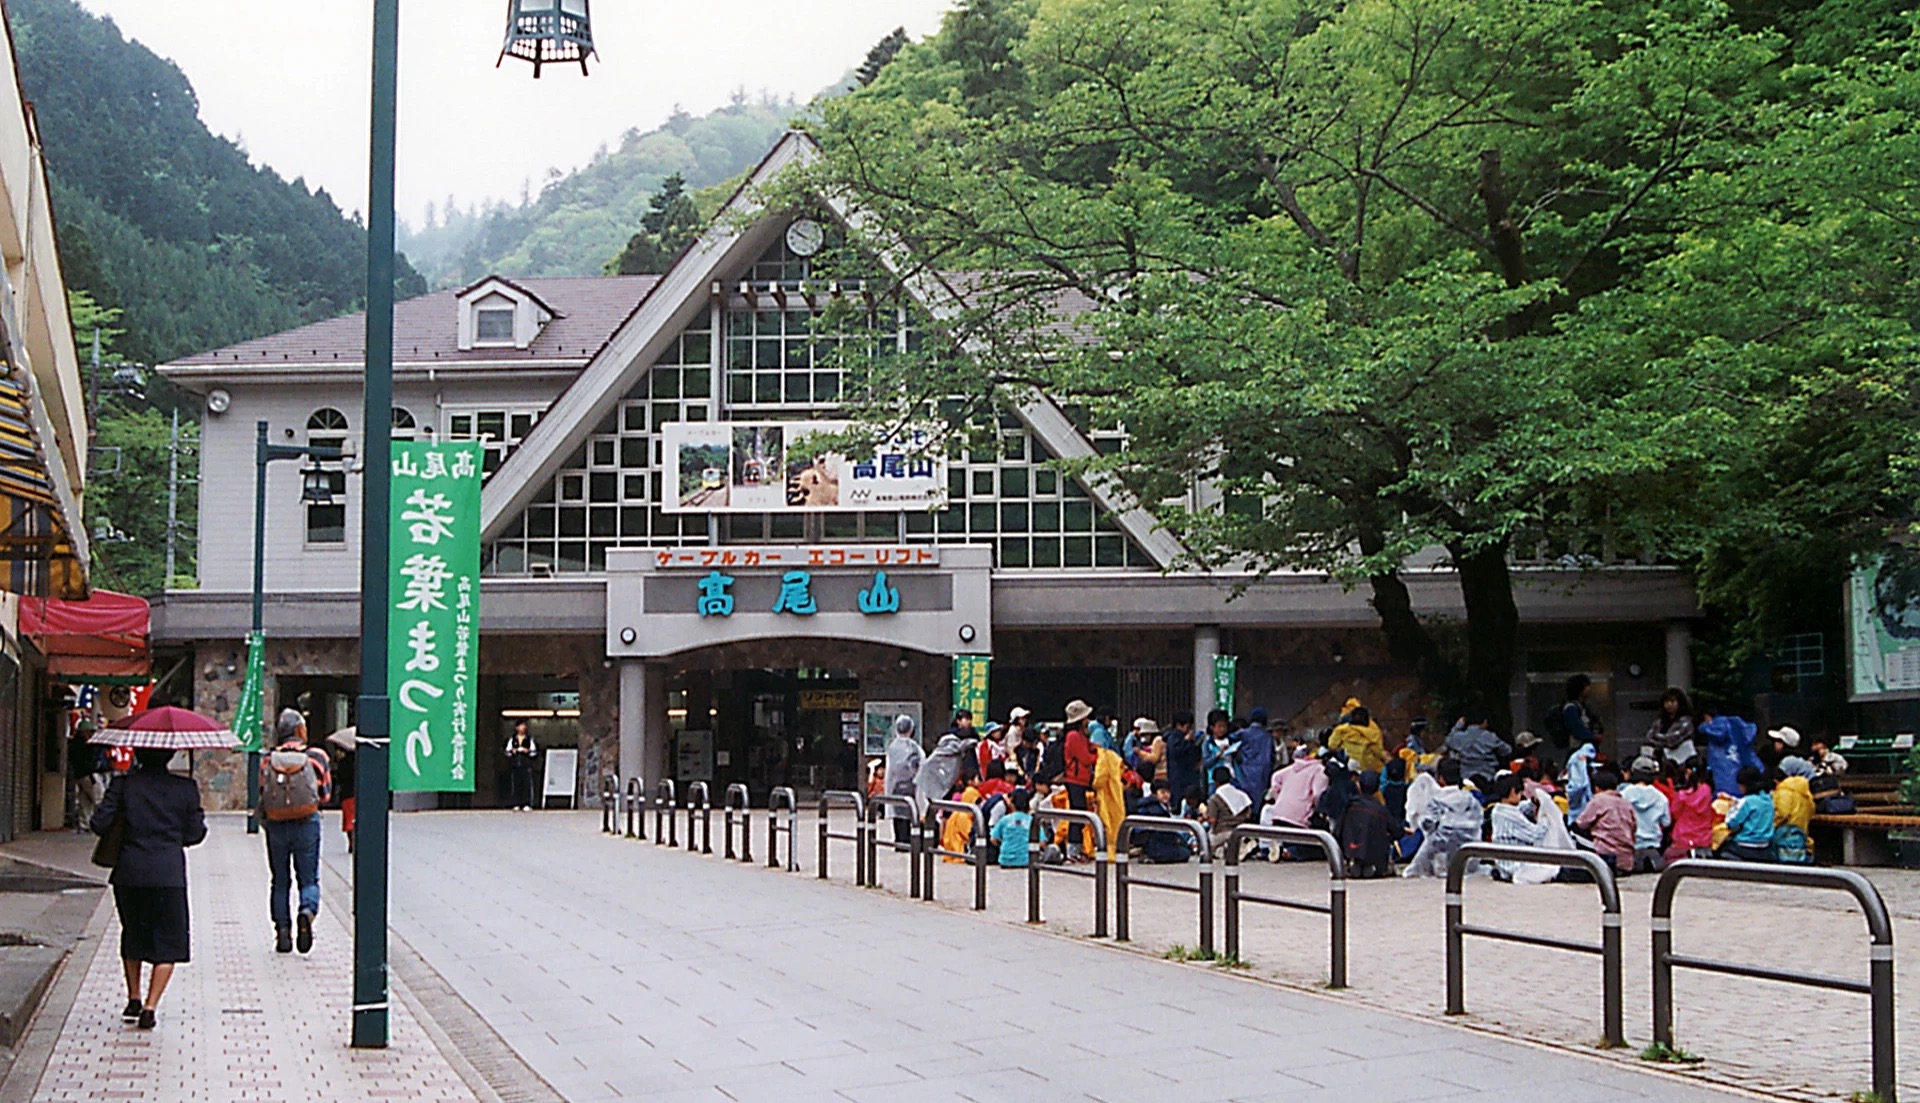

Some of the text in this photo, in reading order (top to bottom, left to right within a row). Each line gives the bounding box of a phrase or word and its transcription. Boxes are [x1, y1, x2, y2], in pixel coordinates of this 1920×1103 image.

[657, 550, 782, 566] ケーブルカー
[808, 549, 934, 564] エコーリフト
